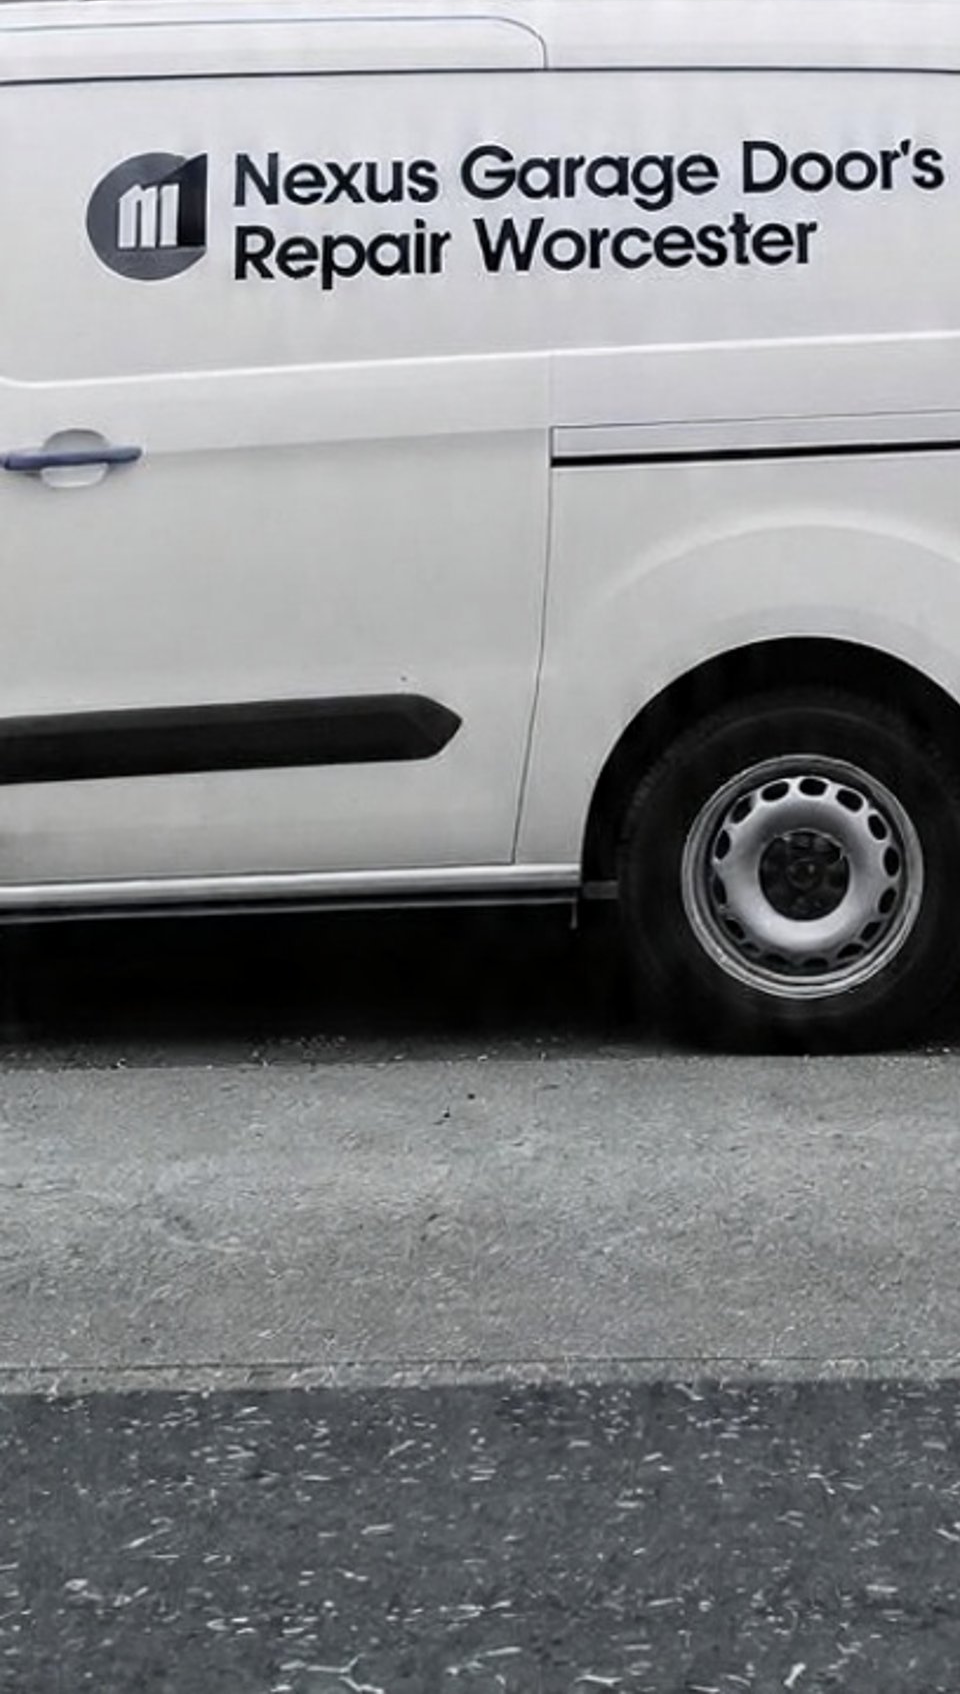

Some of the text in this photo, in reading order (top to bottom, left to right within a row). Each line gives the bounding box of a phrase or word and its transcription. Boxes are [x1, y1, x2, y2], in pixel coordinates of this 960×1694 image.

[234, 138, 945, 212] Nexus Garage Door's
[234, 212, 818, 291] Repair Worcester
